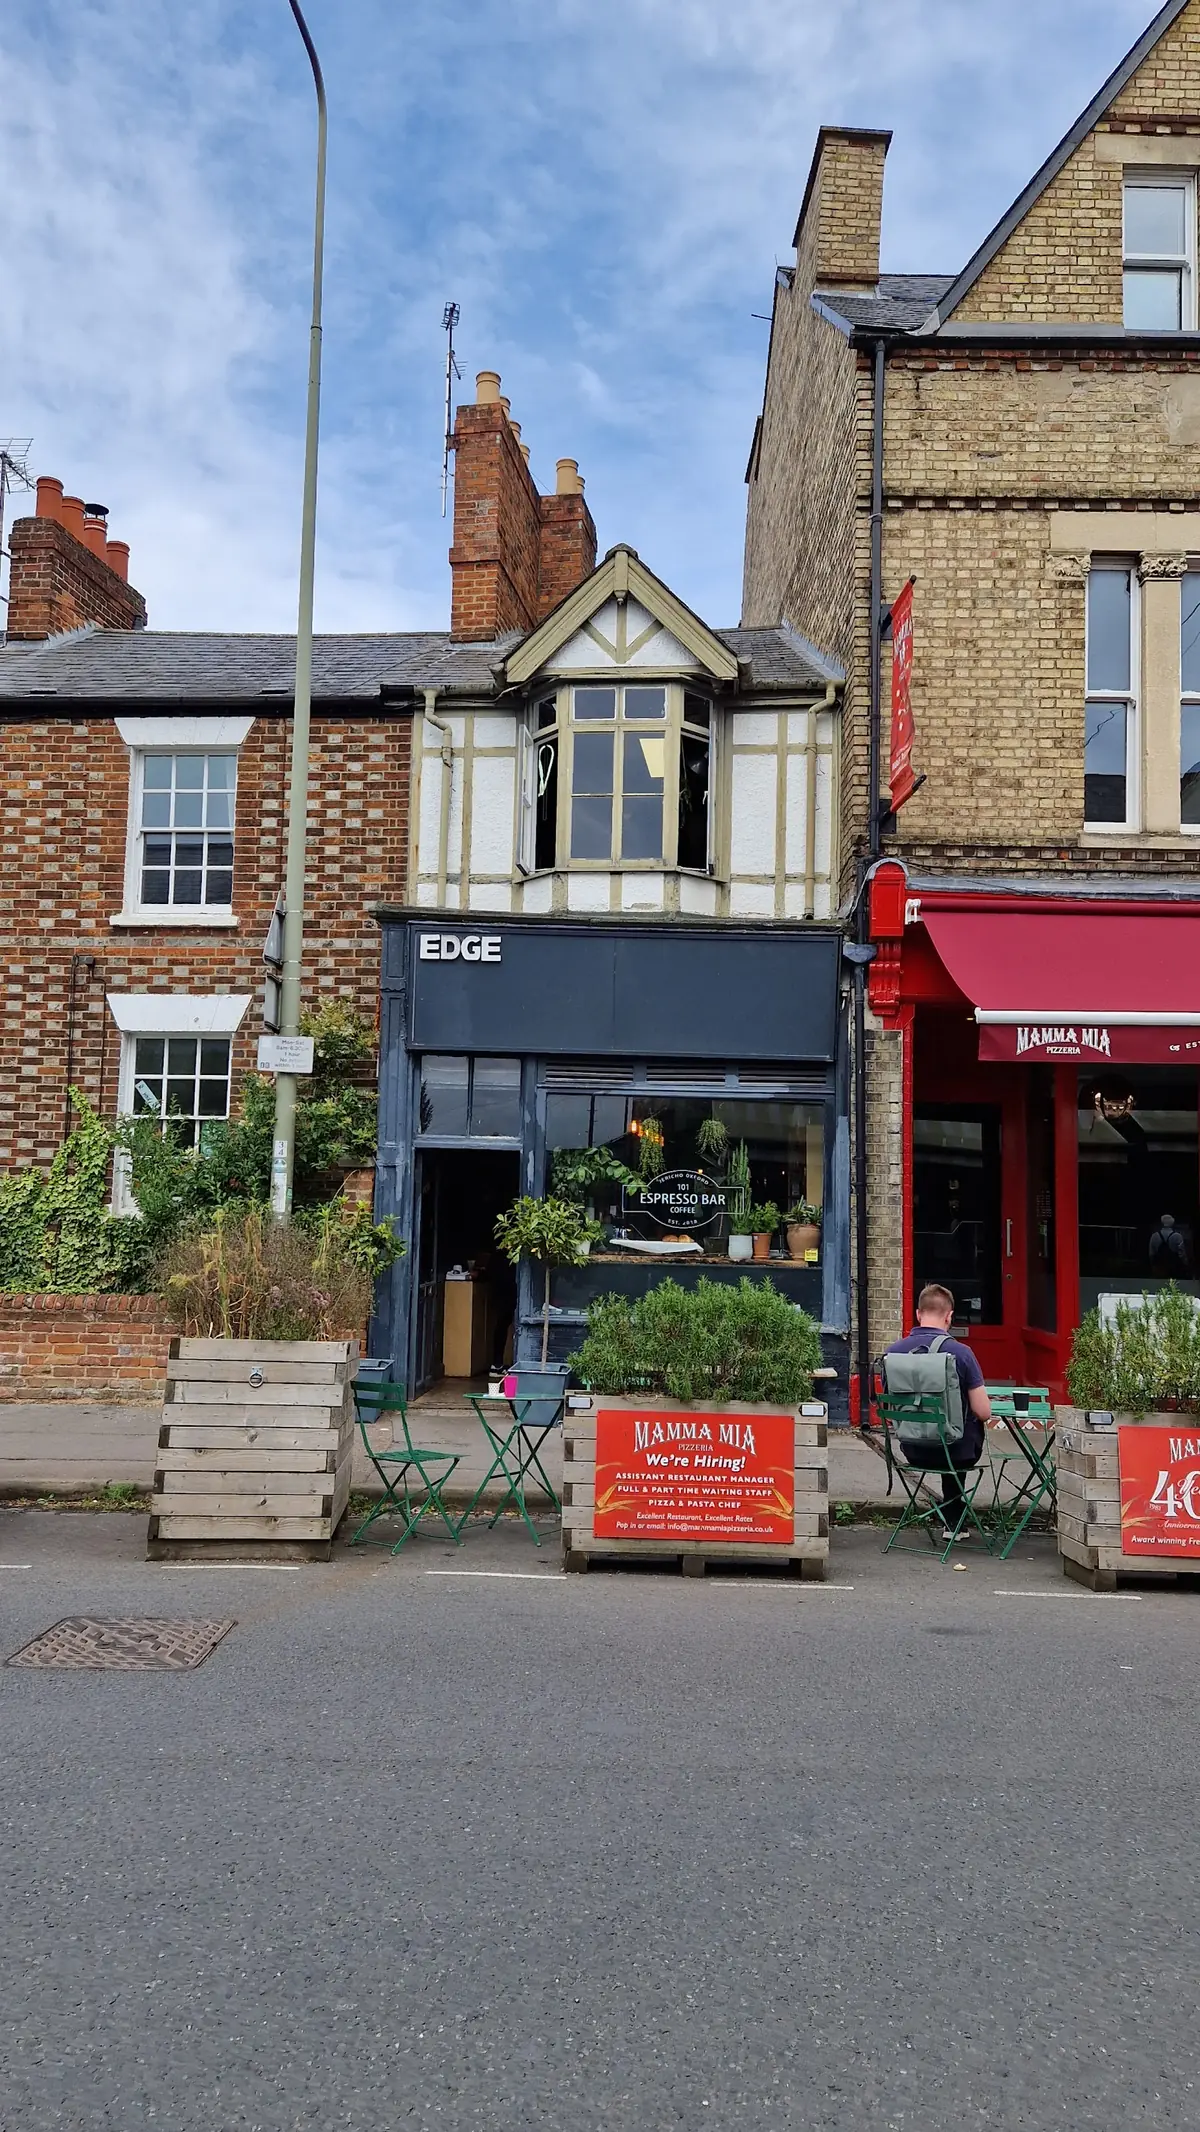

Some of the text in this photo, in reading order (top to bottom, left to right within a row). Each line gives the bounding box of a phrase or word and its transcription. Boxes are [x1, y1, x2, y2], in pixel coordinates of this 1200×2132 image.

[420, 934, 501, 961] EDGE
[1016, 1027, 1111, 1057] MAMMA MIA
[1046, 1046, 1081, 1055] PIZZERIA
[686, 1173, 709, 1185] OXFORD
[640, 1192, 726, 1205] ESPRESSO BAR
[670, 1206, 696, 1214] COFFEE
[634, 1421, 757, 1457] MAMMA MIA
[678, 1443, 713, 1451] PIZZERIA
[646, 1454, 746, 1472] We're Hiring!
[668, 1474, 727, 1482] RESTAURANT
[616, 1521, 628, 1530] Pop
[1157, 1536, 1186, 1546] winning
